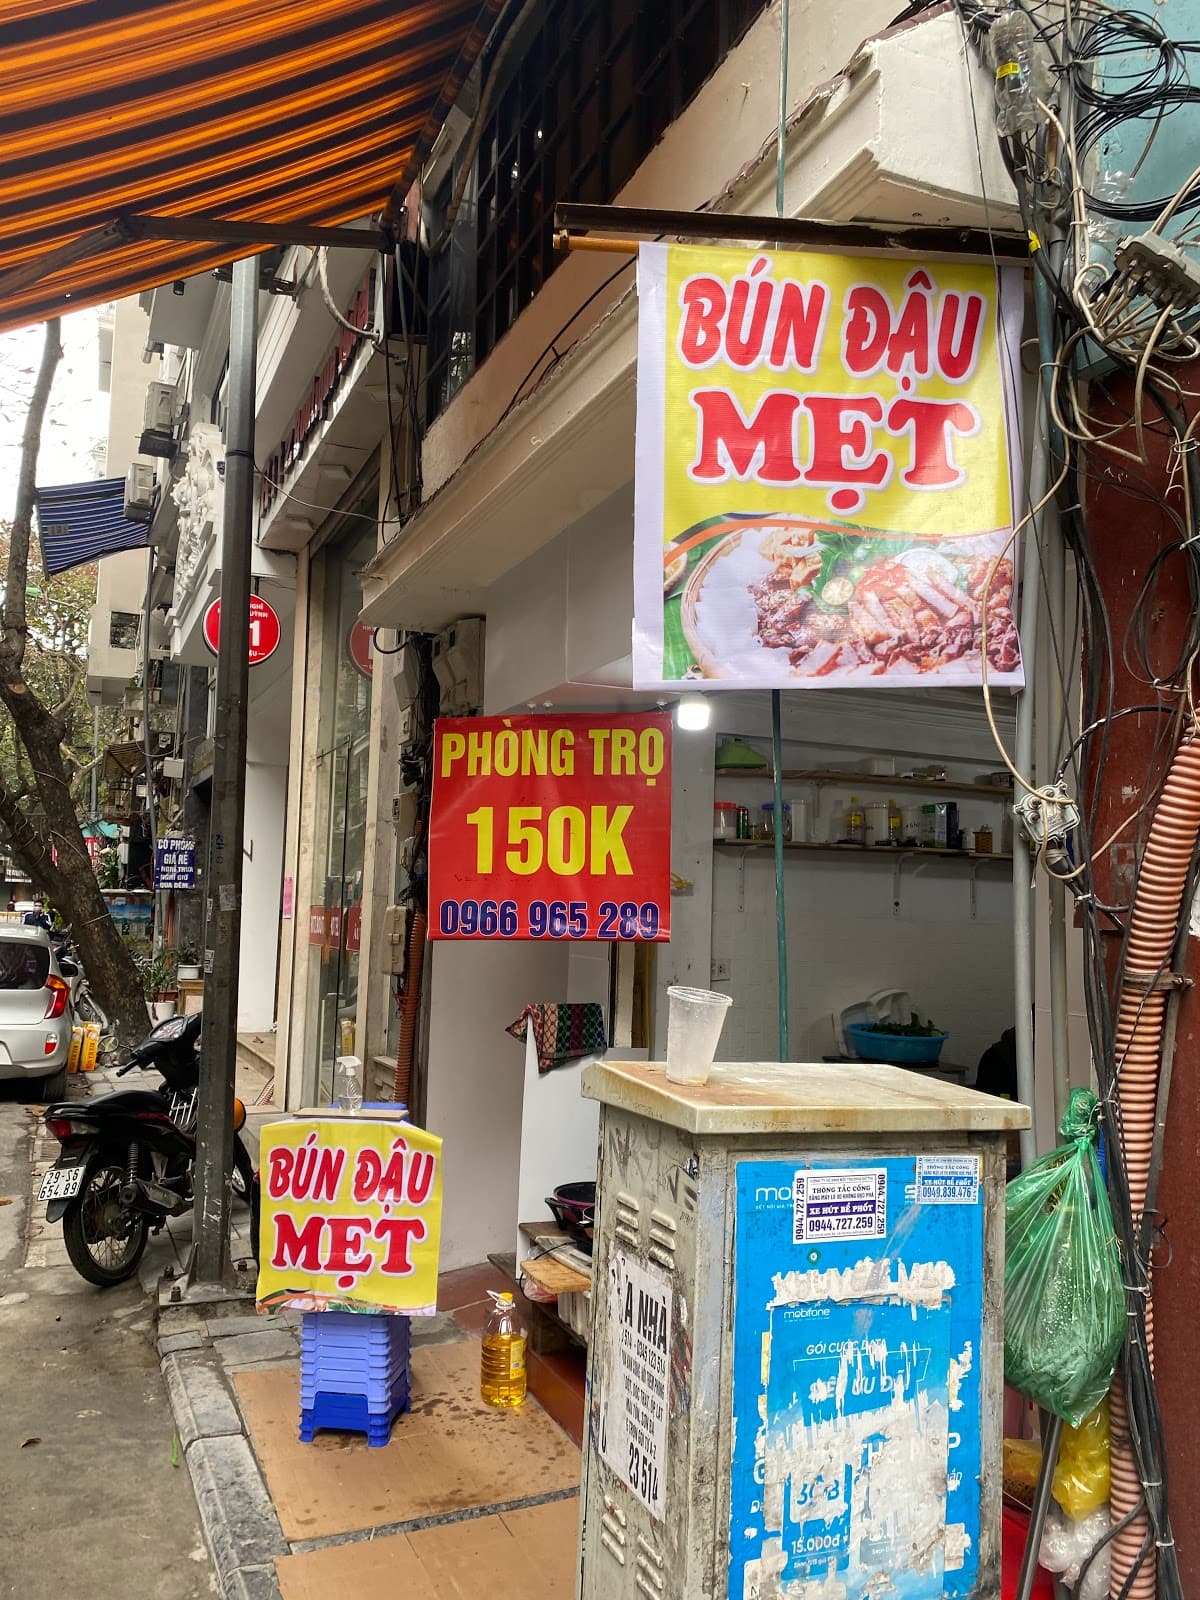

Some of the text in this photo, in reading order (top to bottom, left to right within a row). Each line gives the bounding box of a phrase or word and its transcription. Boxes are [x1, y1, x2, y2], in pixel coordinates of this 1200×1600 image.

[679, 257, 984, 391] BÚN ĐẬU
[690, 390, 979, 511] MẸT
[441, 719, 664, 786] PHÒNG TRỌ
[466, 806, 634, 875] 150K
[440, 899, 659, 938] 0966 965 289
[268, 1133, 434, 1214] BÚN ĐẬU
[812, 1183, 871, 1194] THÔNG TẮC CỐNG
[922, 1186, 972, 1198] 0949.839.476
[795, 1177, 805, 1241] 0944.727.259
[809, 1207, 821, 1216] XE
[822, 1205, 840, 1215] HÚT
[852, 1201, 873, 1213] PHỐT
[809, 1216, 873, 1233] 0944.727.259
[877, 1174, 886, 1235] 0944.727.259
[271, 1214, 425, 1288] MẸT
[637, 1289, 667, 1355] NHÀ
[783, 1307, 830, 1319] mobifone
[806, 1341, 826, 1355] GÓI
[641, 1454, 658, 1504] 514
[791, 1533, 840, 1555] 15.000đ
